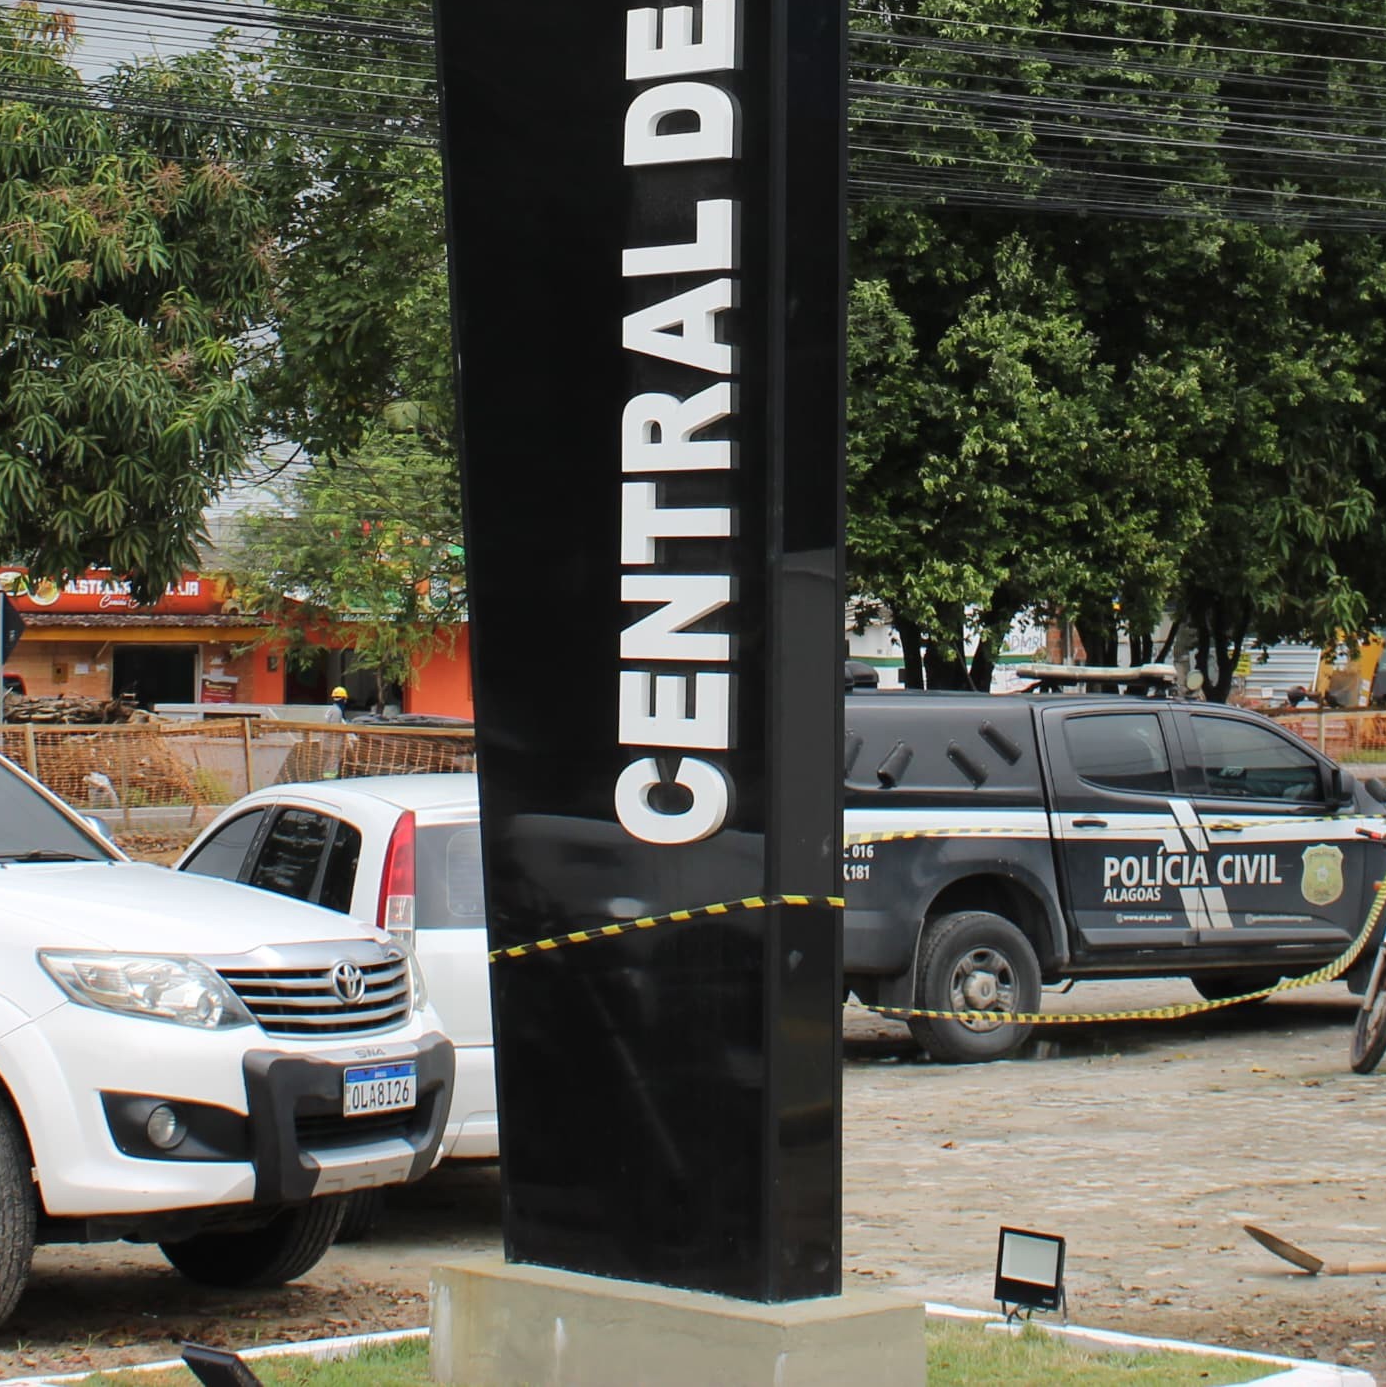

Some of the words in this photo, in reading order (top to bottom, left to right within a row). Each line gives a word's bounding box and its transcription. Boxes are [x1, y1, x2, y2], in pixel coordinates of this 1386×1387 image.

[615, 197, 741, 845] CENTRAL
[849, 864, 870, 880] 181
[1103, 846, 1210, 887] POLÍCIA
[1217, 854, 1282, 884] CIVIL
[1103, 887, 1161, 903] ALAGOAS
